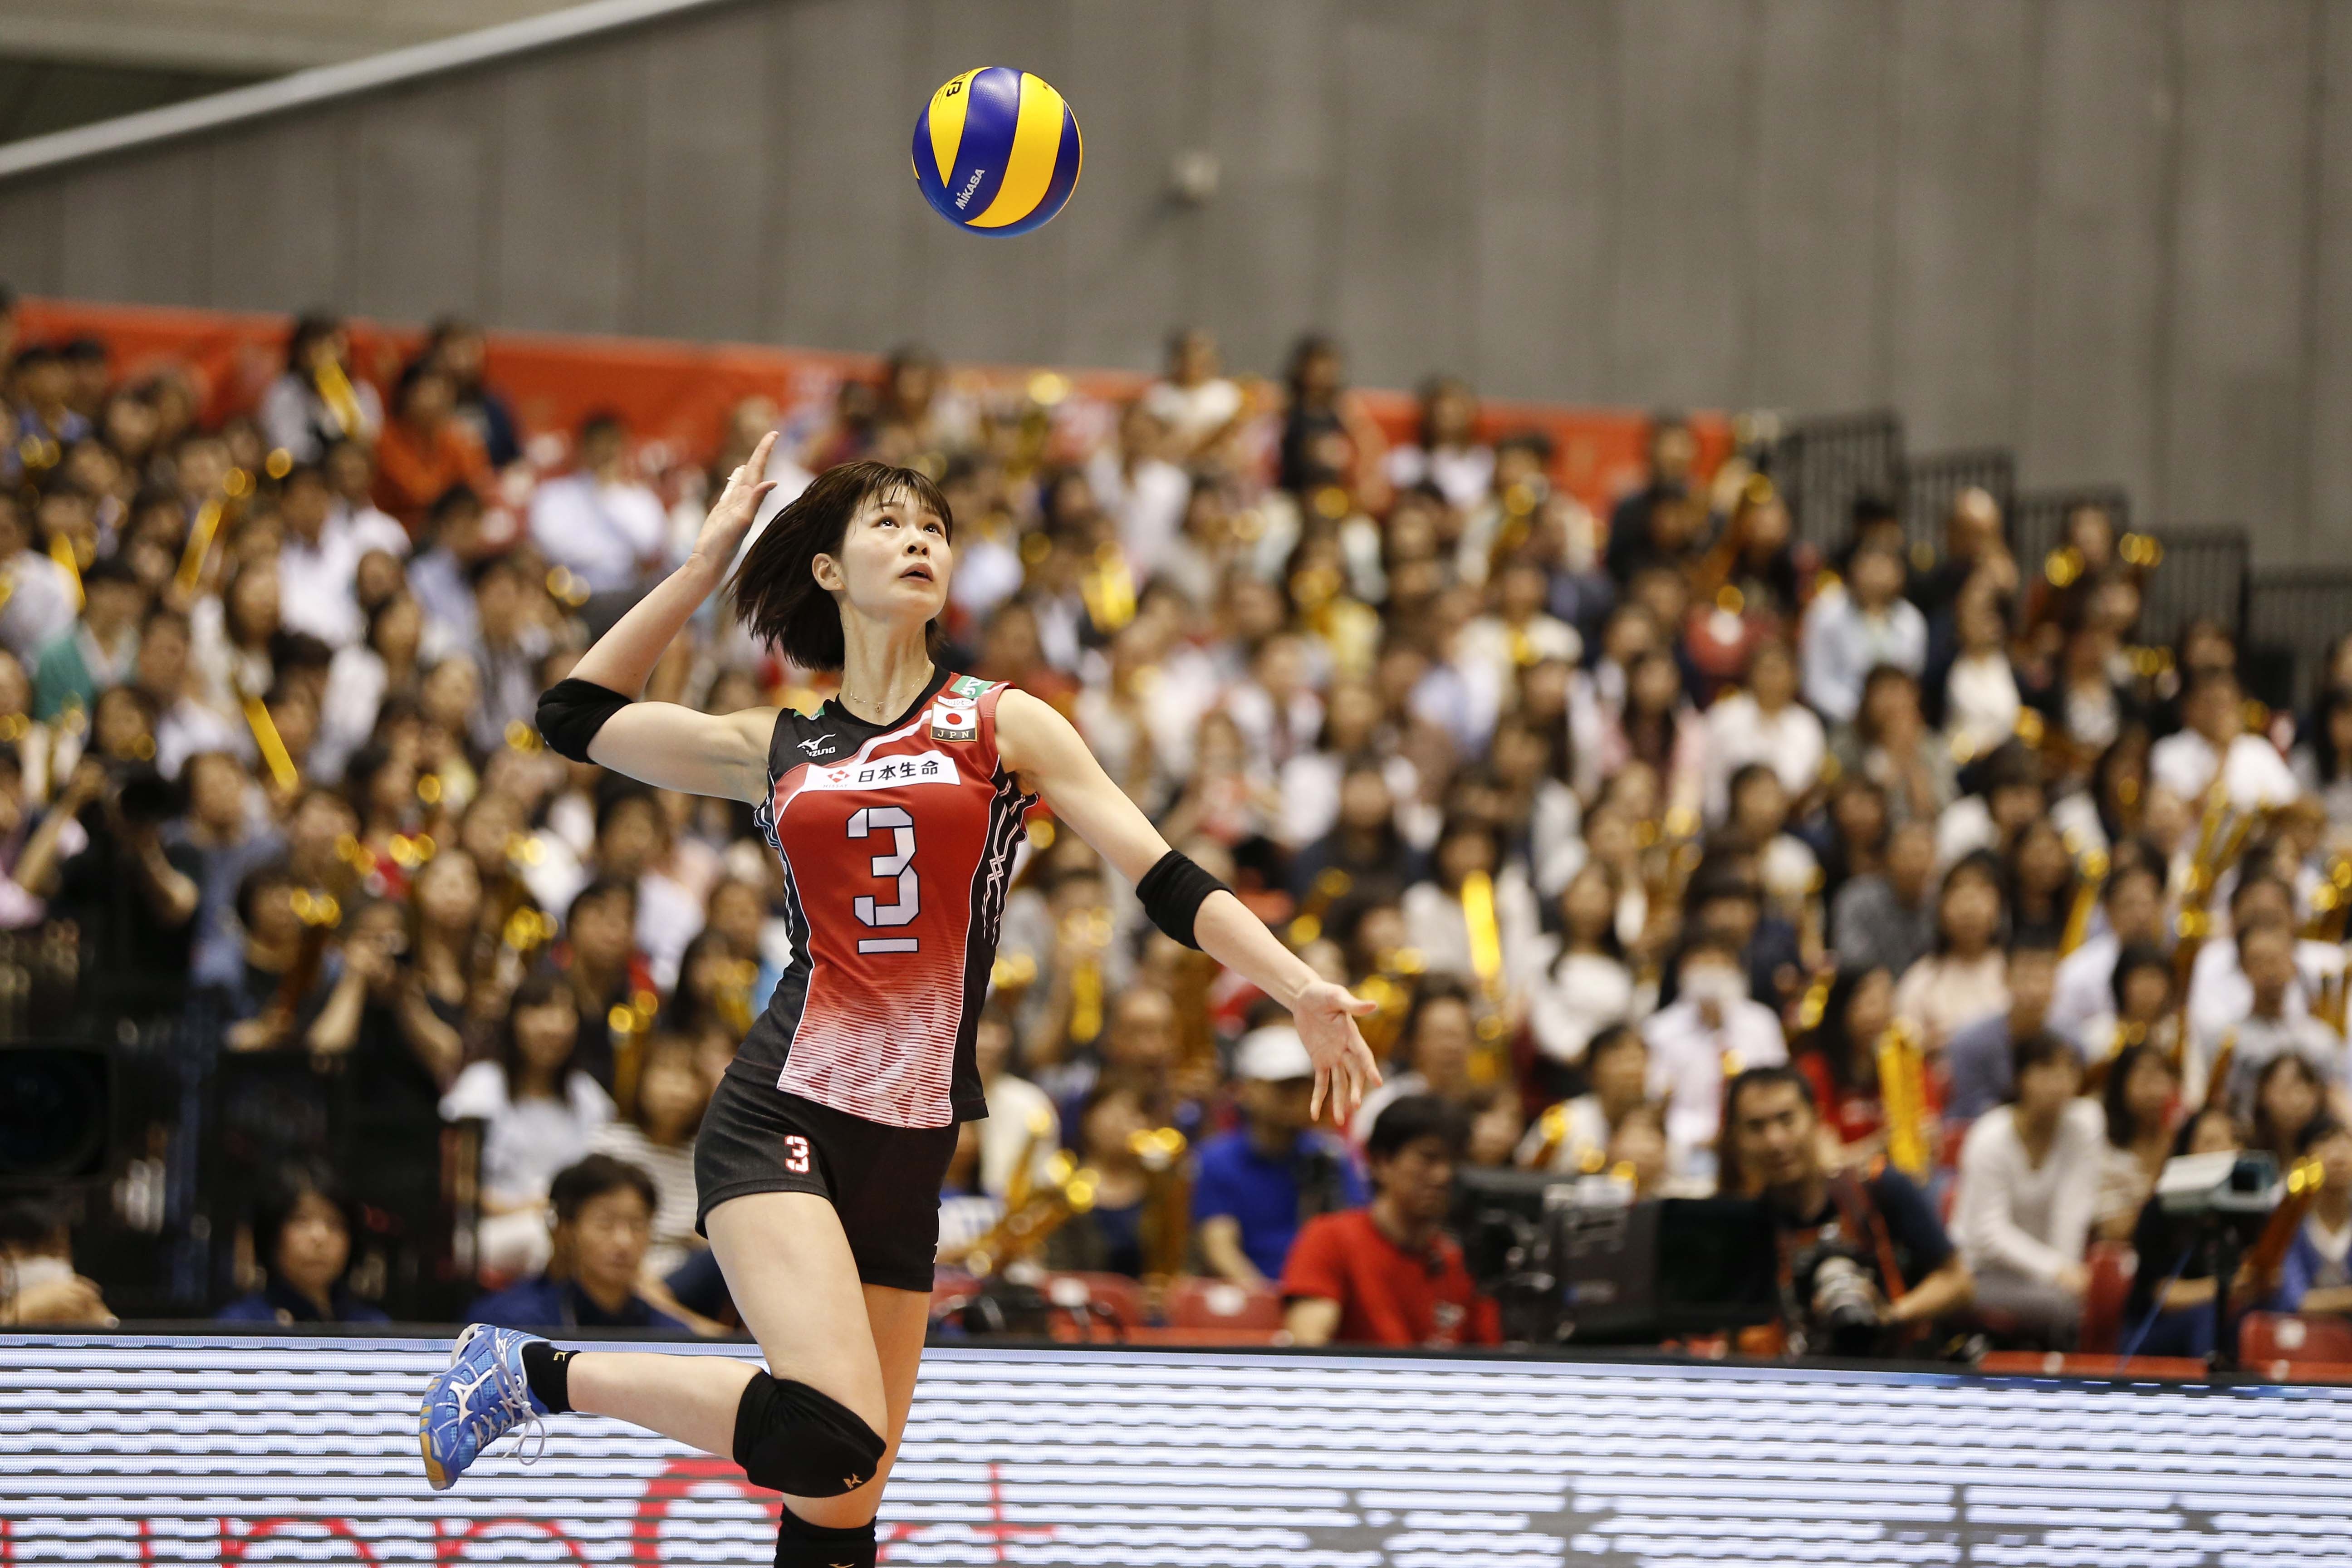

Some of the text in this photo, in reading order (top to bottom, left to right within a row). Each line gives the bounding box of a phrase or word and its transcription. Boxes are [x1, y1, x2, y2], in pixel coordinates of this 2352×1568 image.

[955, 169, 985, 210] MIKASA
[937, 730, 970, 739] JPN
[858, 760, 939, 783] 日本生命
[846, 805, 921, 927] 3
[784, 1135, 810, 1174] 3
